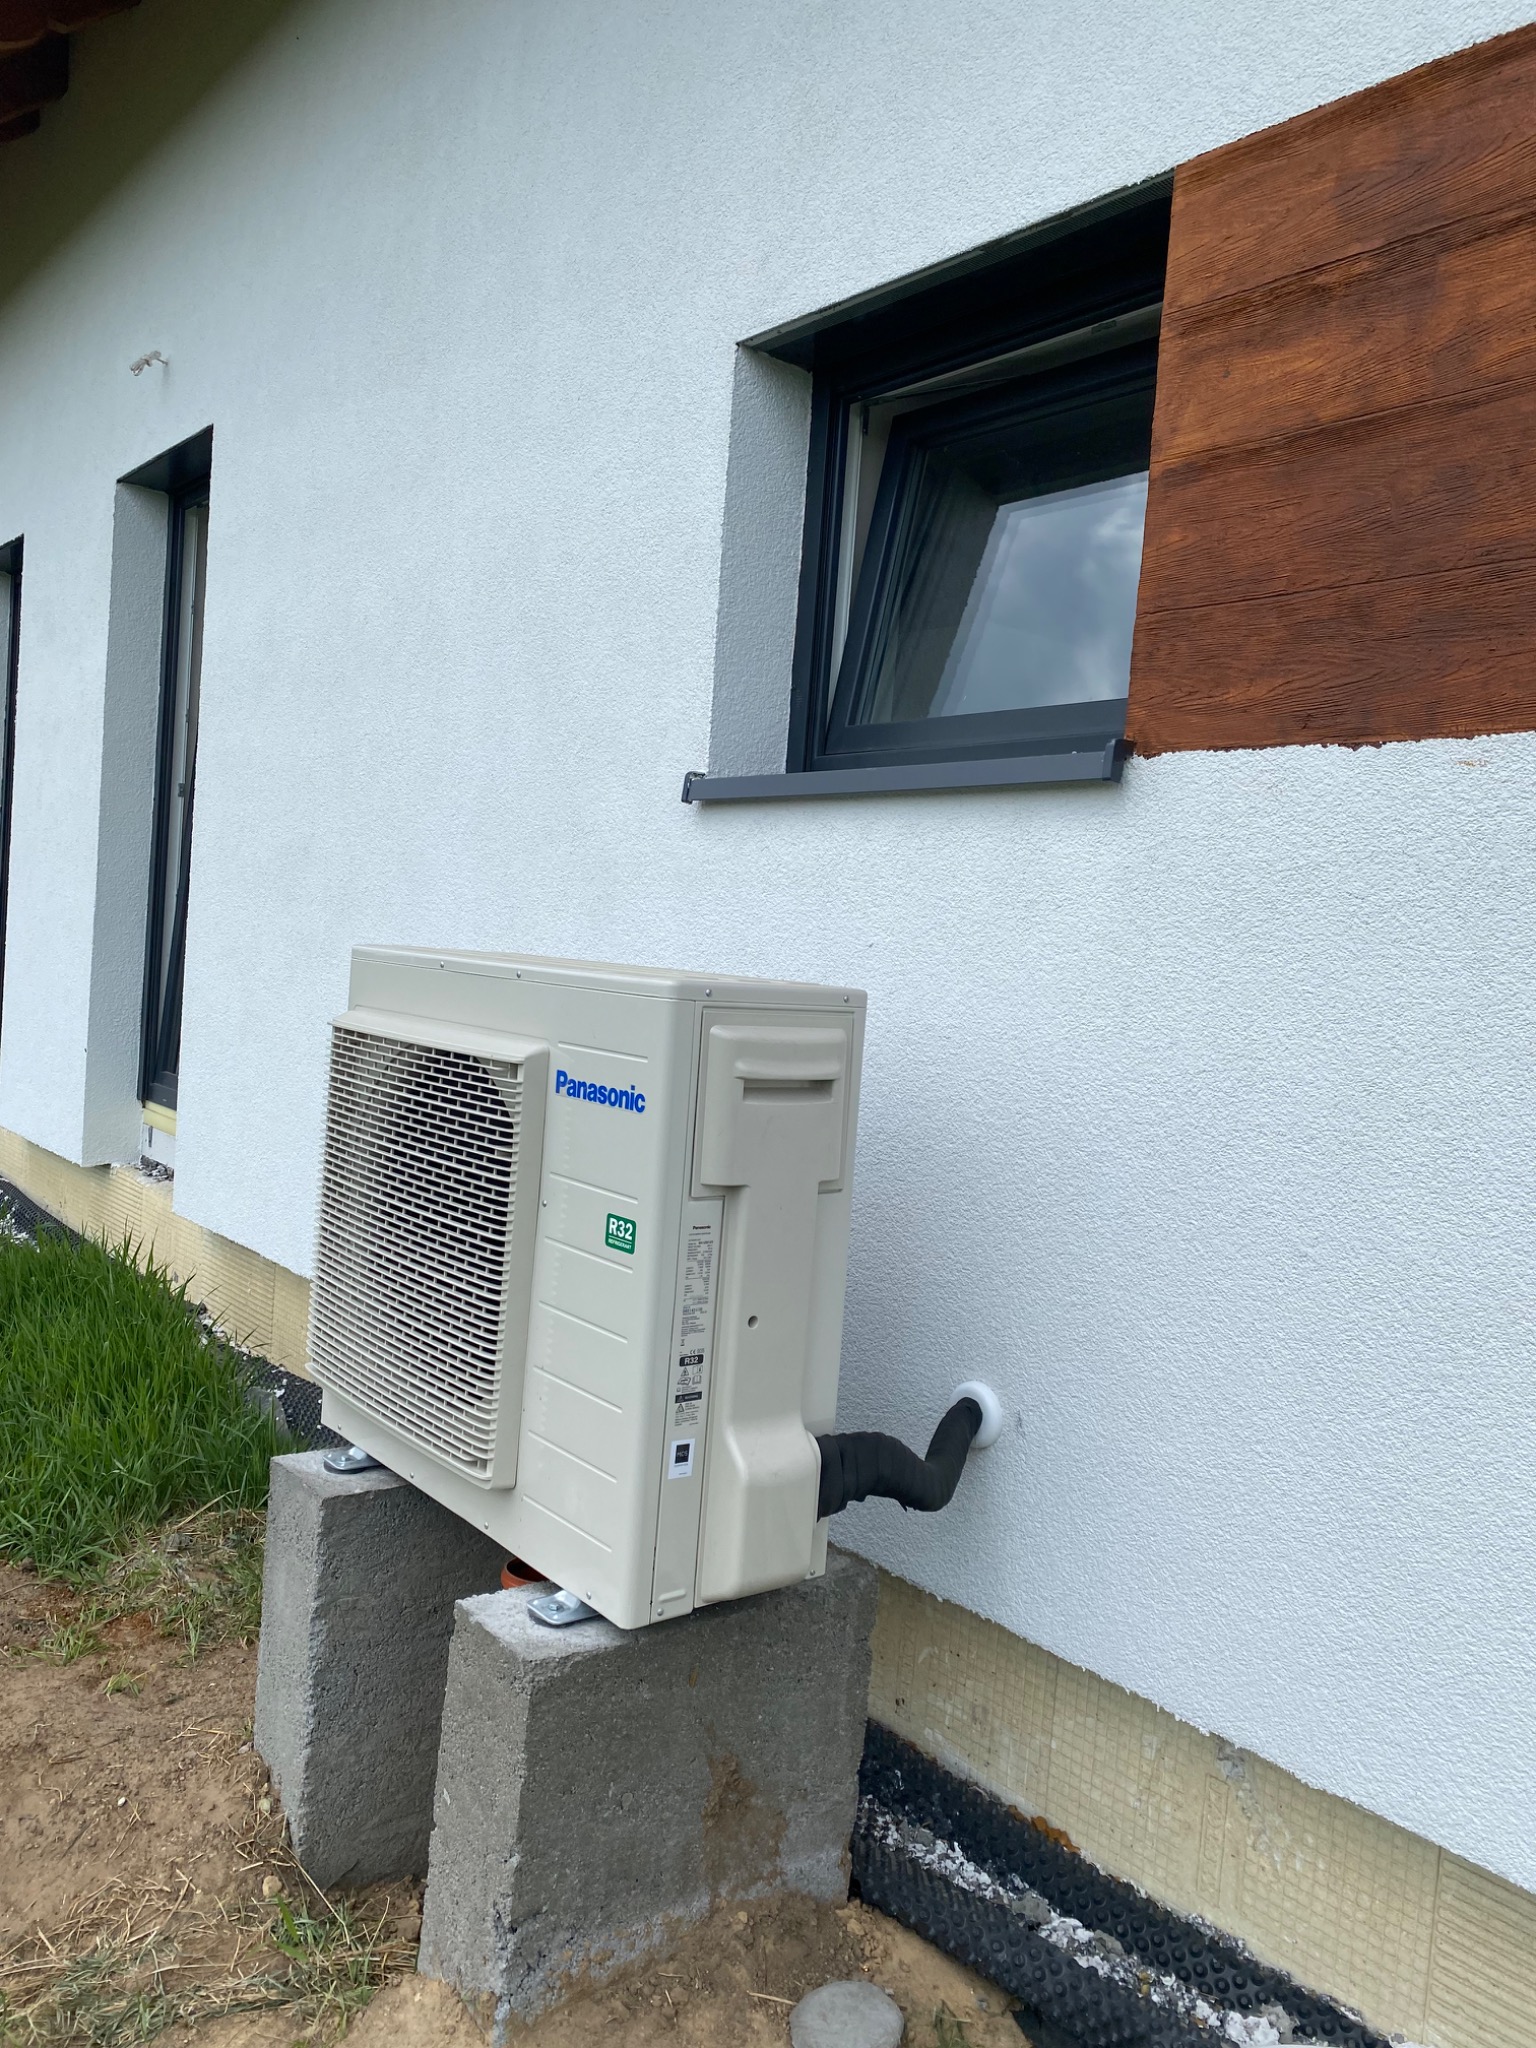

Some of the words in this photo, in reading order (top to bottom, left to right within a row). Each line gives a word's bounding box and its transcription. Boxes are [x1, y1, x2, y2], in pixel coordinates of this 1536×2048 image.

[555, 1069, 646, 1114] Panasonic
[609, 1217, 633, 1240] R32
[684, 1356, 699, 1365] R32
